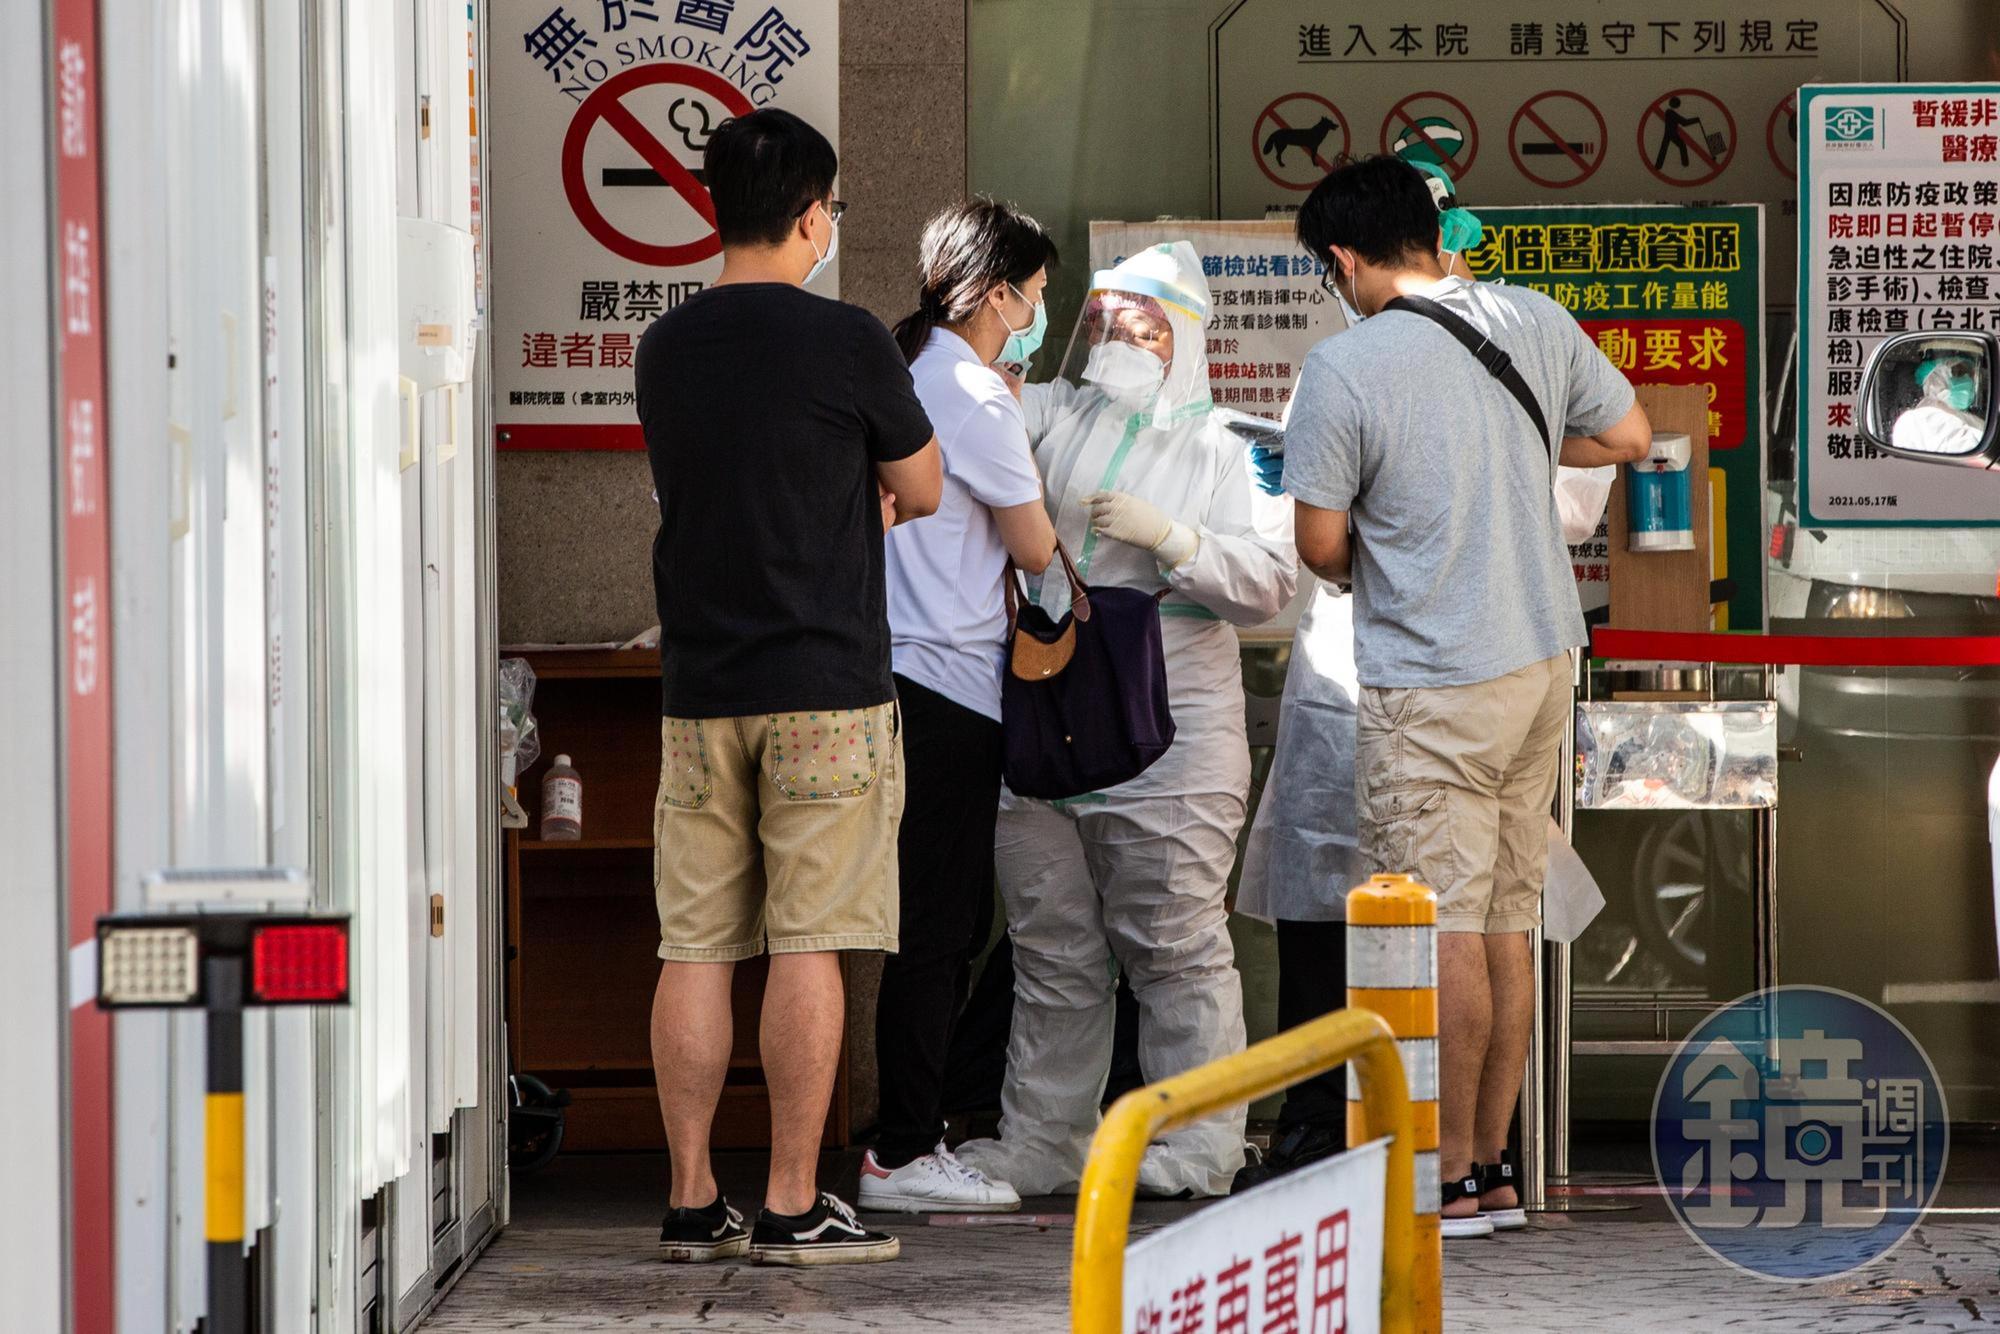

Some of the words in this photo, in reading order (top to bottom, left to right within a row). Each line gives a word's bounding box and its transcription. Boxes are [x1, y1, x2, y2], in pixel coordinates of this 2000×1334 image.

[1298, 24, 1469, 57] 進入本院
[1510, 19, 1819, 56] 請遵守下列規定
[560, 60, 608, 103] NO
[615, 35, 778, 105] SMOKING
[1912, 98, 1998, 128] 暫緩非
[1942, 134, 1998, 162] 醫療
[1828, 181, 1998, 207] 因應防疫政策
[1828, 212, 2000, 239] 院即日起暫停
[521, 332, 642, 369] 違者最
[1597, 326, 1729, 371] 動要求
[1827, 433, 1893, 460] 敬請
[1136, 1208, 1350, 1334] 車專用
